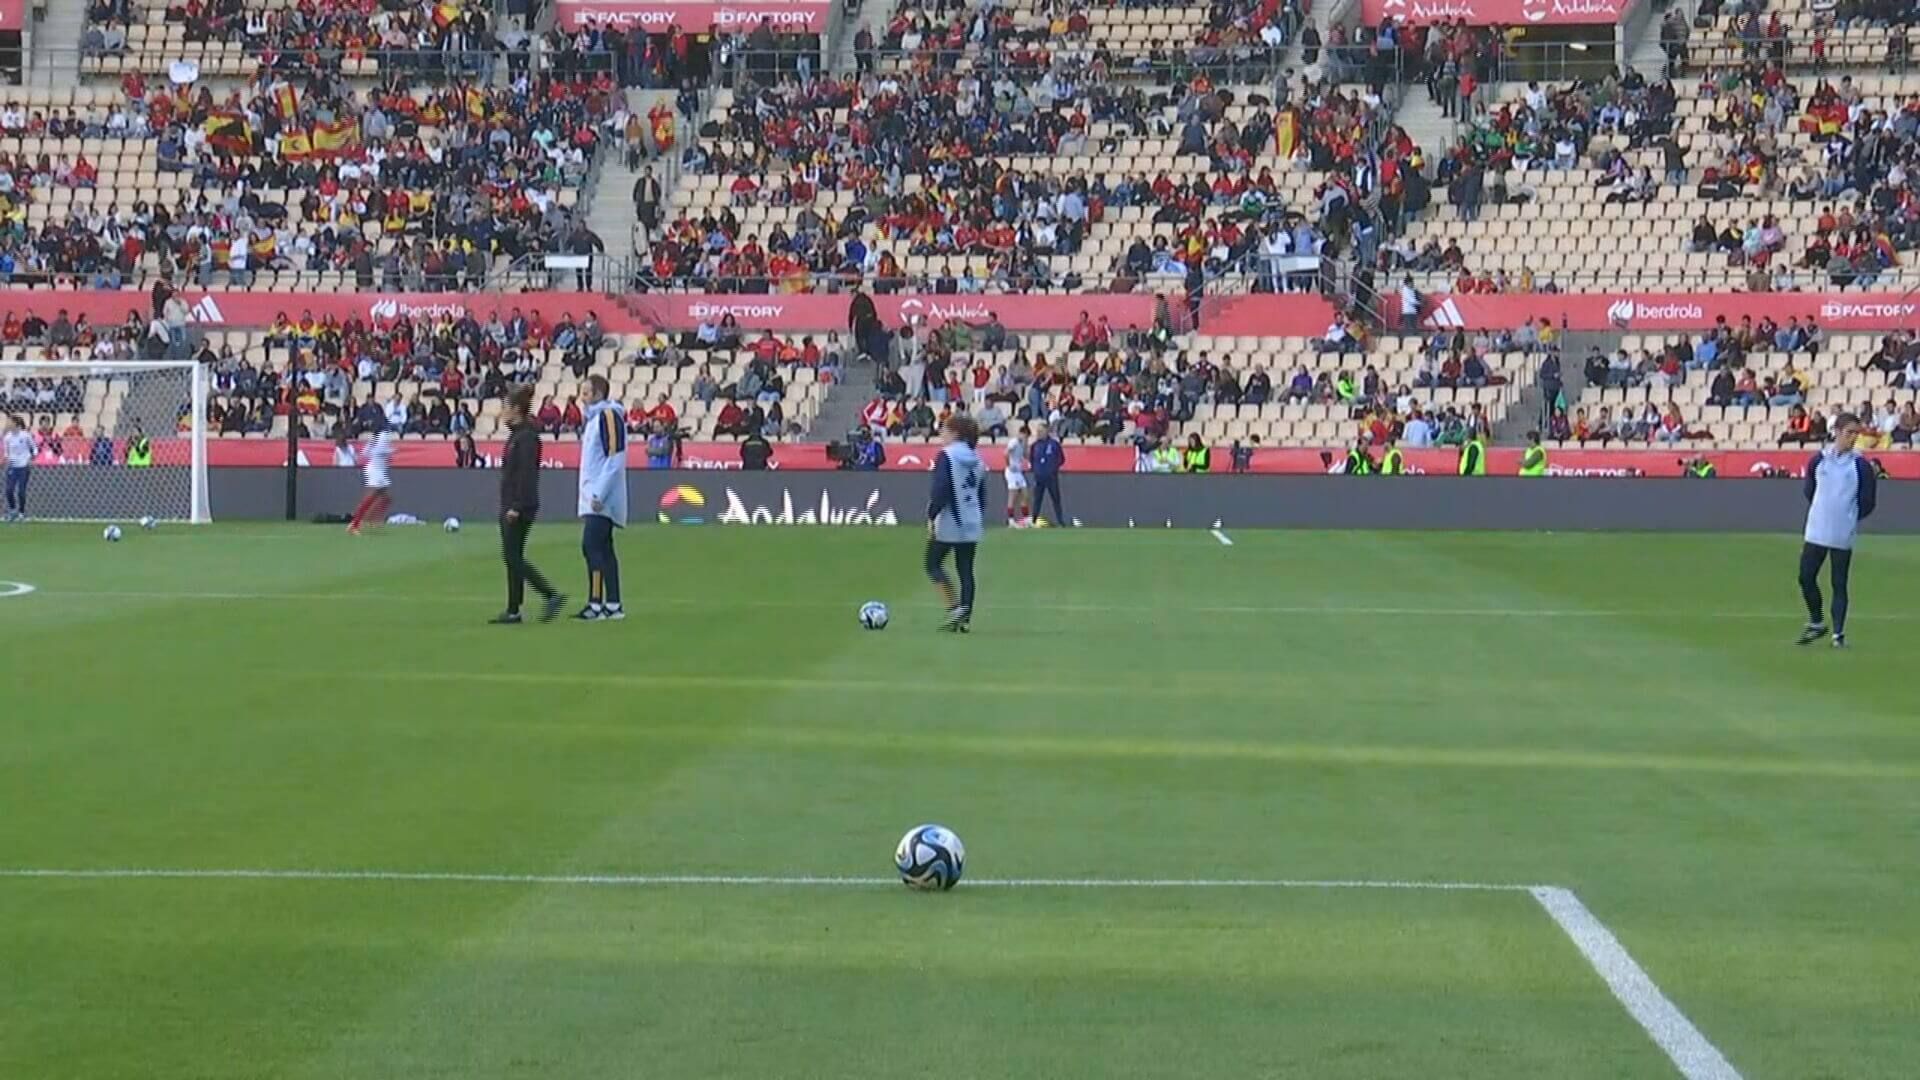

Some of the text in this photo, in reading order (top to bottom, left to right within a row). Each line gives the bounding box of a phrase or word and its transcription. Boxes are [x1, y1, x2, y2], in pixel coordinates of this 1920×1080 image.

[710, 305, 783, 317] FACTORY
[1636, 303, 1703, 319] Iberdrola
[717, 486, 898, 525] Andalucía
